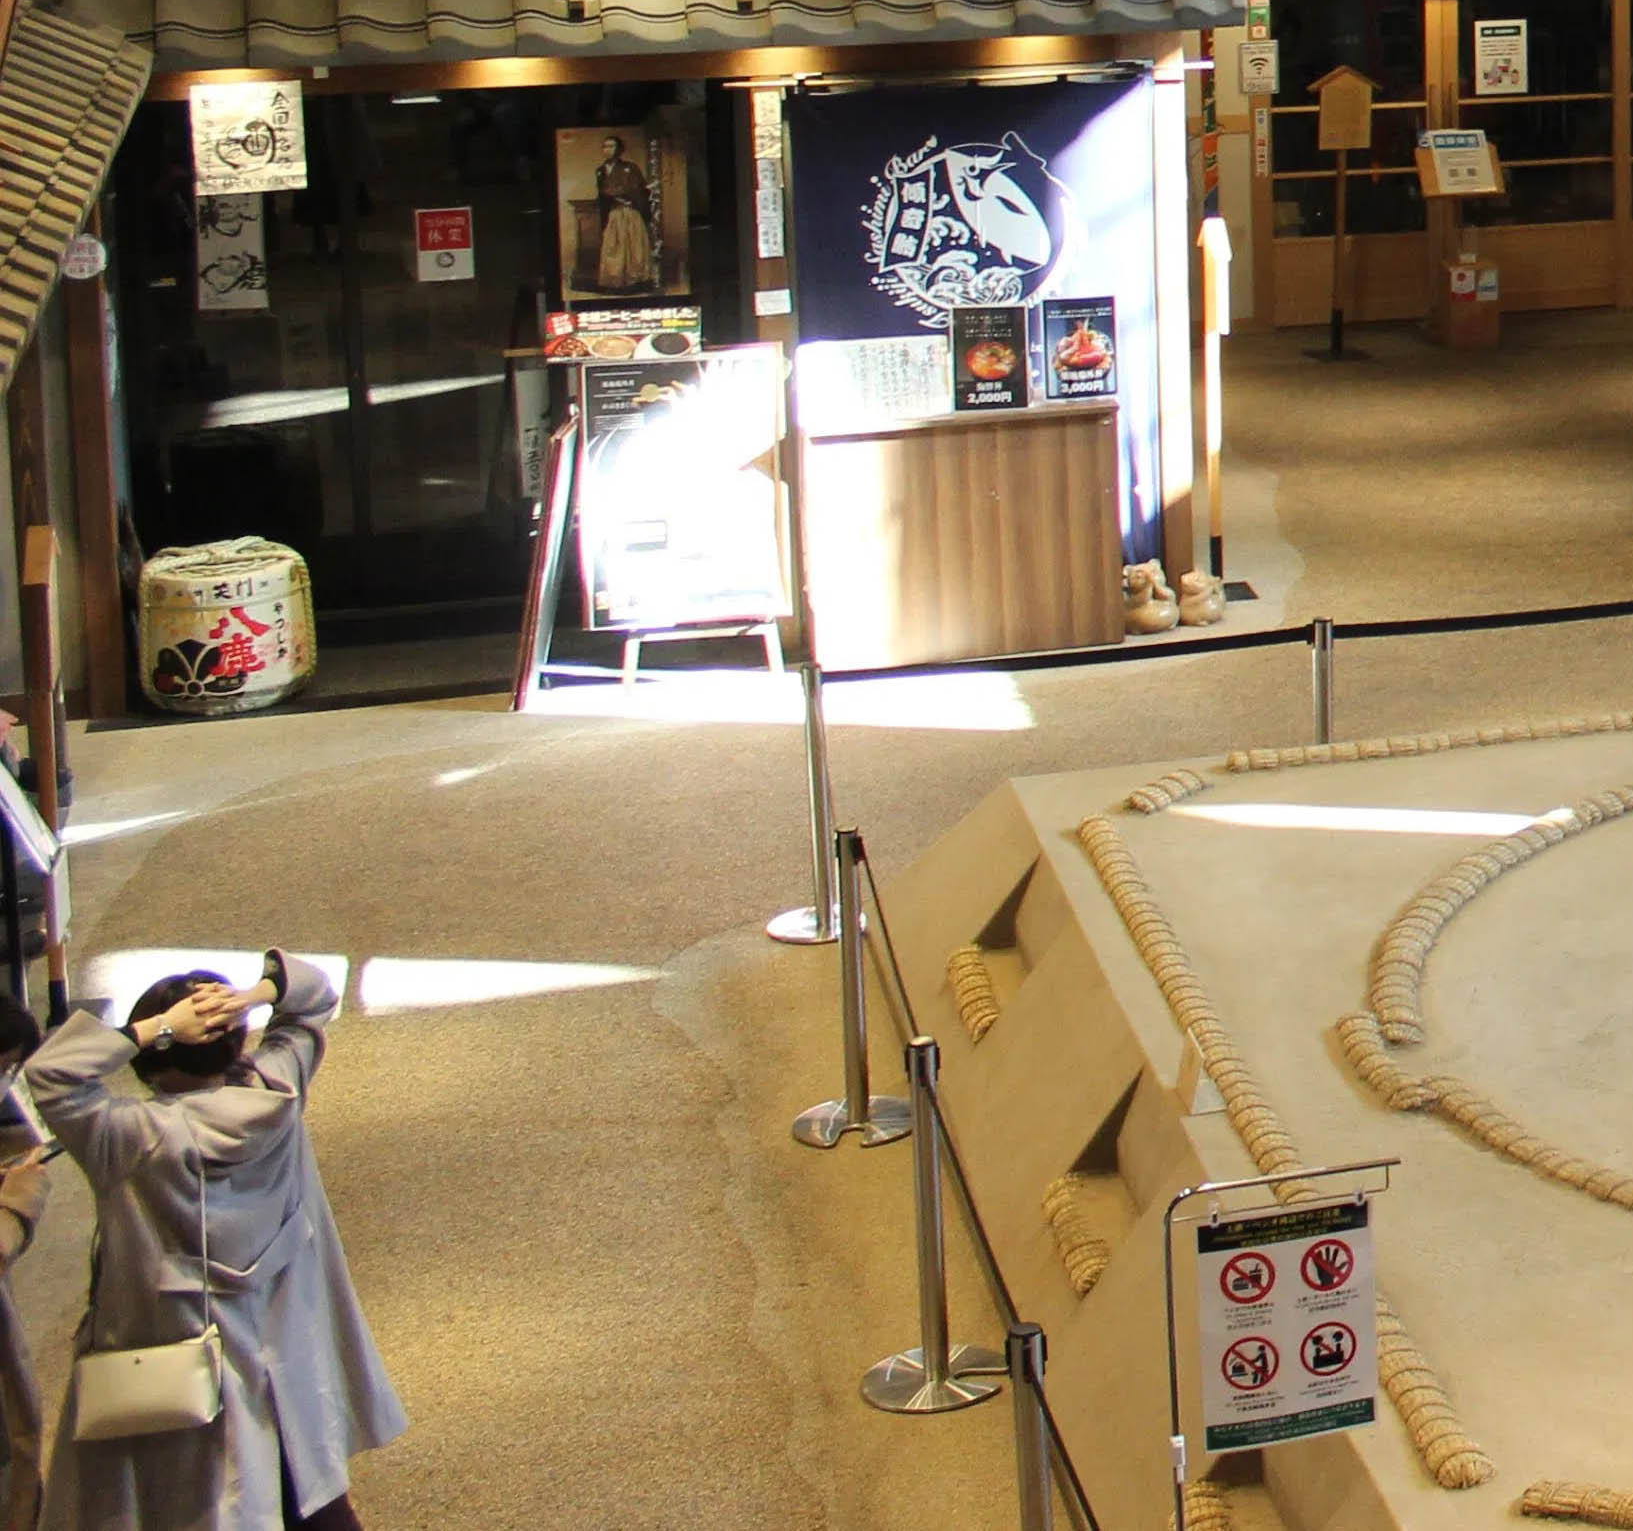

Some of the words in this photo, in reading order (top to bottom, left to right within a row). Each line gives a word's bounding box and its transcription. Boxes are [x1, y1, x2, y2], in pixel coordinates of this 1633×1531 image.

[967, 391, 1013, 404] 2,000円
[1060, 381, 1104, 395] 3,000円
[213, 578, 253, 600] 笑門
[273, 601, 288, 659] やつしか
[208, 606, 270, 677] 八鹿
